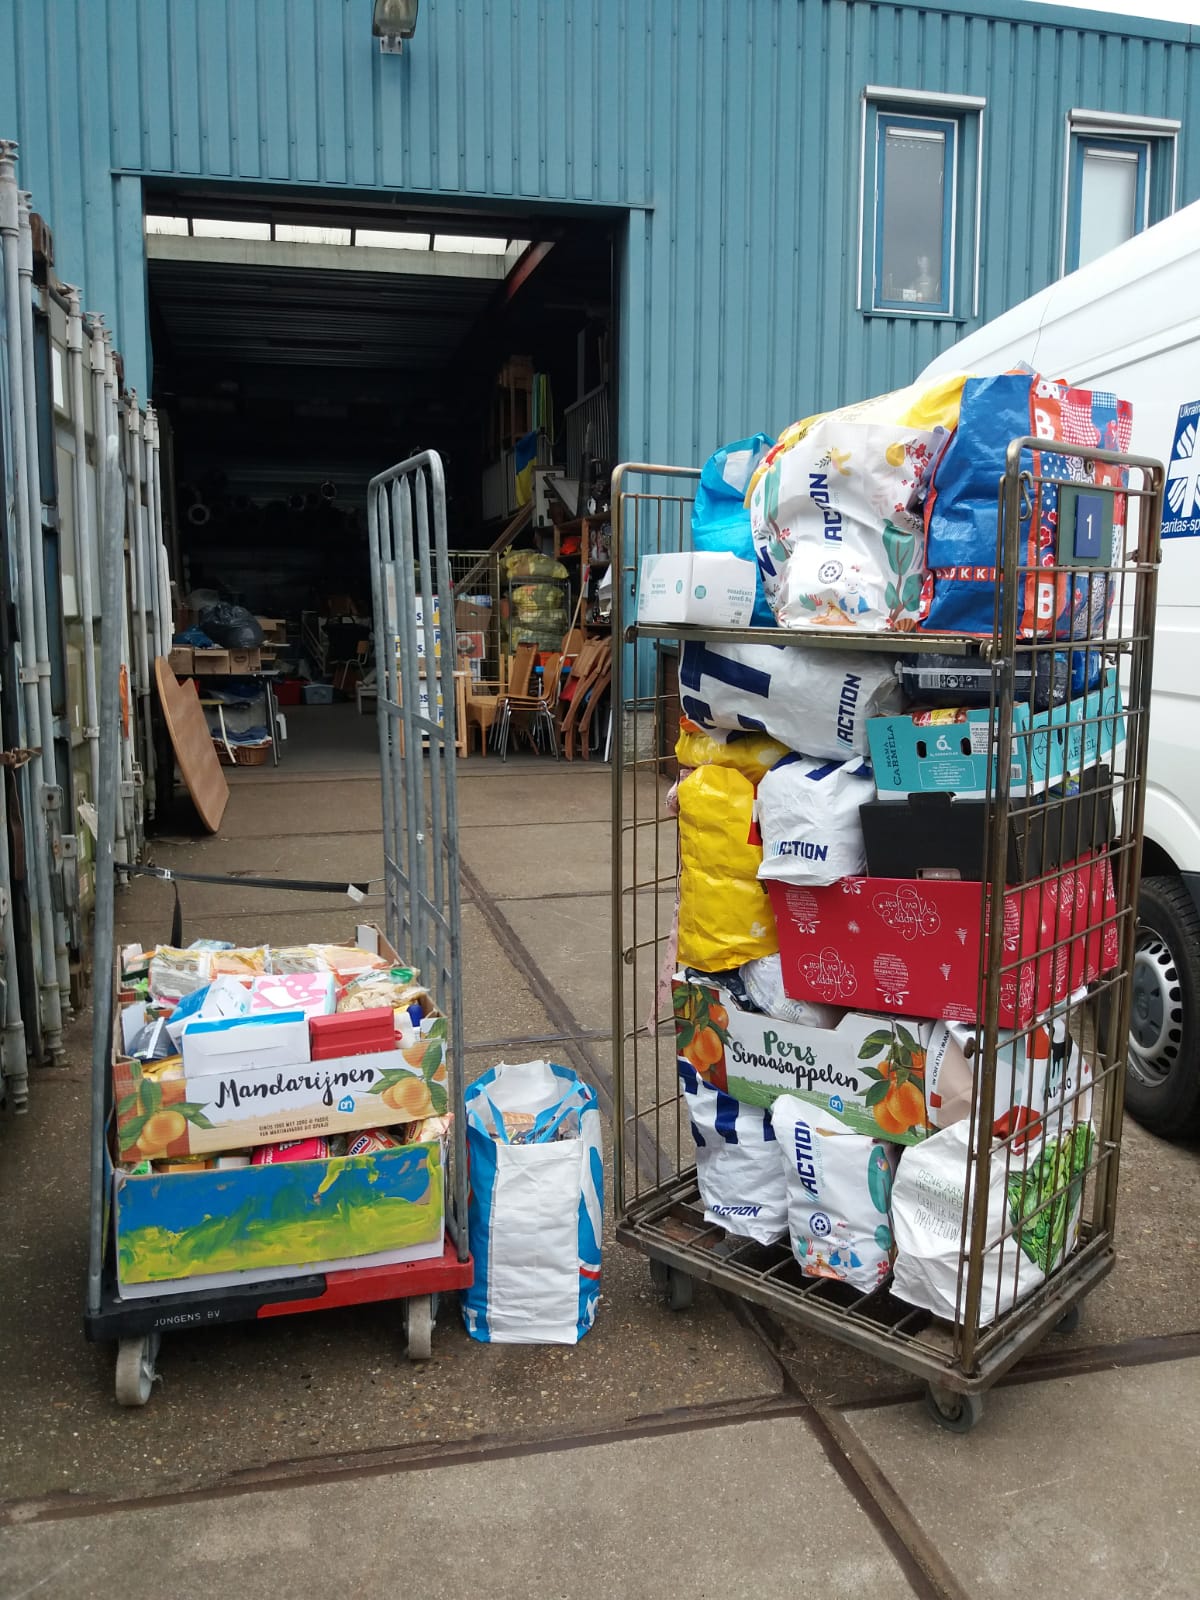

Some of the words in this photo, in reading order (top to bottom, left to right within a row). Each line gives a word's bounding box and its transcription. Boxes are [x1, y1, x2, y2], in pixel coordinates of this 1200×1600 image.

[1086, 514, 1093, 540] 1
[836, 673, 862, 743] ACTION
[778, 840, 829, 862] ACTION
[763, 1030, 817, 1066] Pers
[732, 1041, 859, 1092] Sinaasappelen
[215, 1068, 375, 1107] Mandarijnen
[207, 1309, 221, 1319] BV
